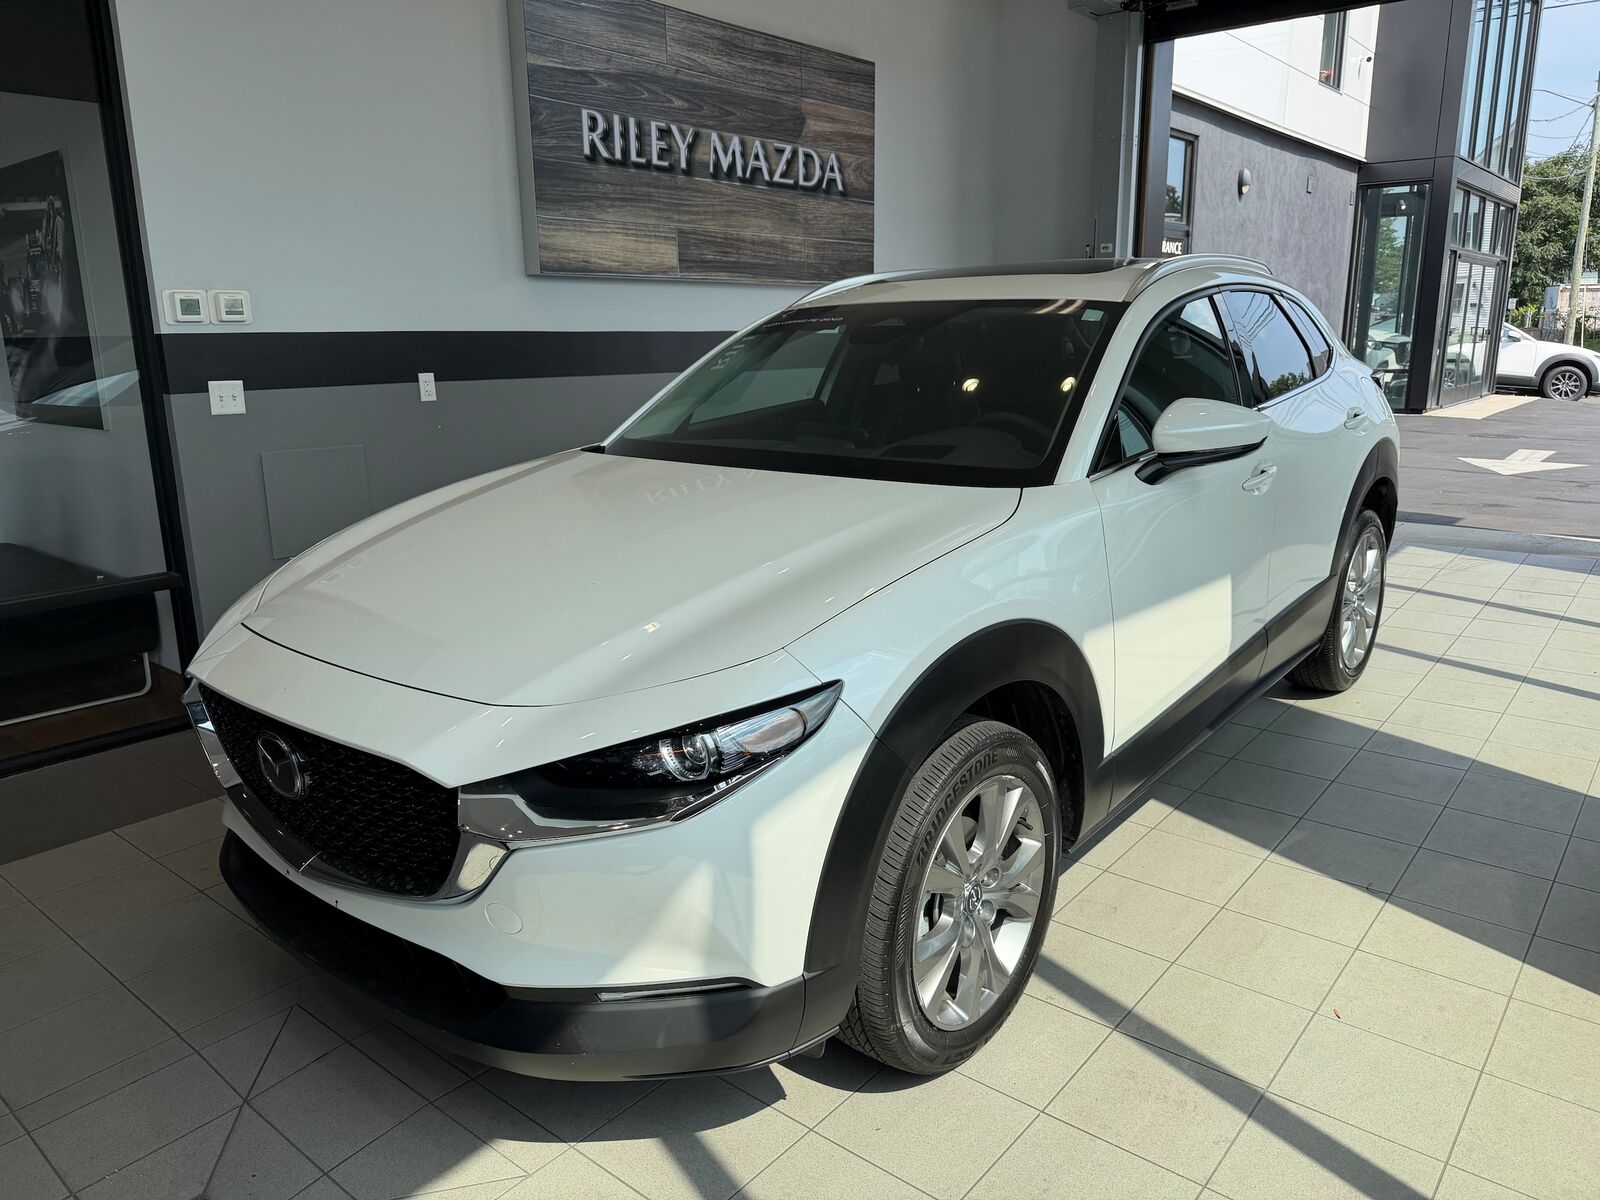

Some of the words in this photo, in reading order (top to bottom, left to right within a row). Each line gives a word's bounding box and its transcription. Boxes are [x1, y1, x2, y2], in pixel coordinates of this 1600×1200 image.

[581, 108, 698, 173] RILEY
[709, 131, 847, 194] MAZDA
[915, 749, 999, 867] BRIDGESTONE
